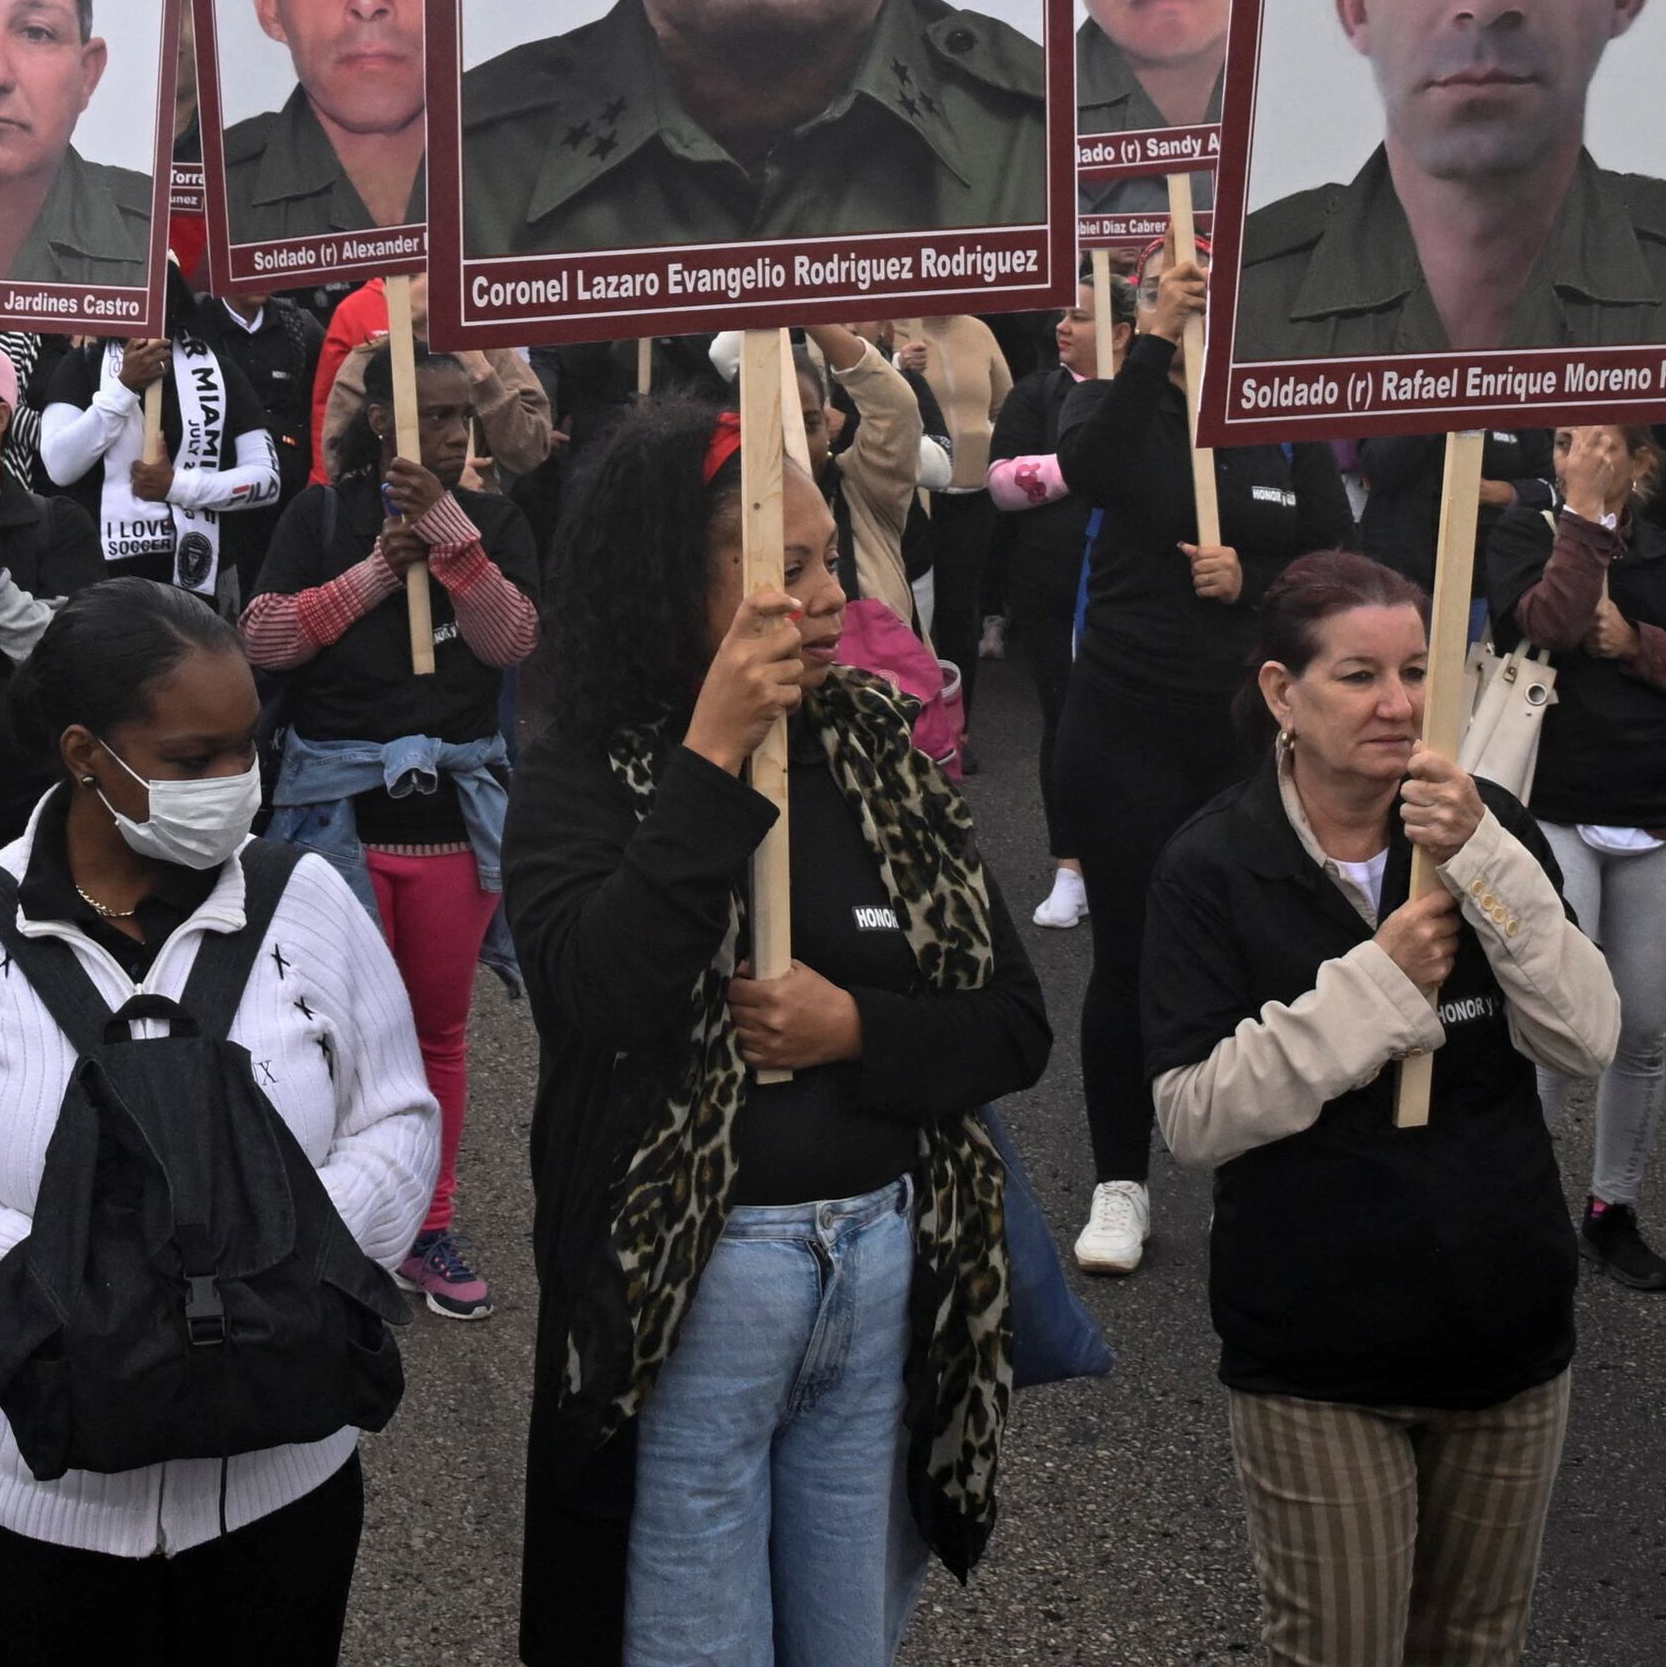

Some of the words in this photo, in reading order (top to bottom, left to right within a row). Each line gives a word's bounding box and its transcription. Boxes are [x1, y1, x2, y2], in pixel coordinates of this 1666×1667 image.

[1121, 140, 1141, 164] (r)
[1147, 134, 1202, 158] Sandy
[1129, 219, 1167, 234] Cabrer
[254, 246, 317, 271] Soldado
[321, 243, 338, 267] (r)
[343, 235, 419, 260] Alexander
[473, 271, 568, 308] Coronel
[578, 269, 660, 301] Lazaro
[668, 258, 786, 299] Evangelio
[795, 253, 913, 291] Rodriguez
[921, 245, 1038, 283] Rodriguez
[5, 291, 78, 314] Jardines
[84, 295, 140, 317] Castro
[1241, 375, 1339, 410] Soldado
[1348, 371, 1373, 411] (r)
[1382, 368, 1459, 401] Rafael
[1466, 365, 1557, 402] Enrique
[1565, 363, 1652, 393] Moreno
[191, 367, 220, 469] MIAMI
[187, 419, 201, 456] JULY
[119, 519, 174, 539] LOVE
